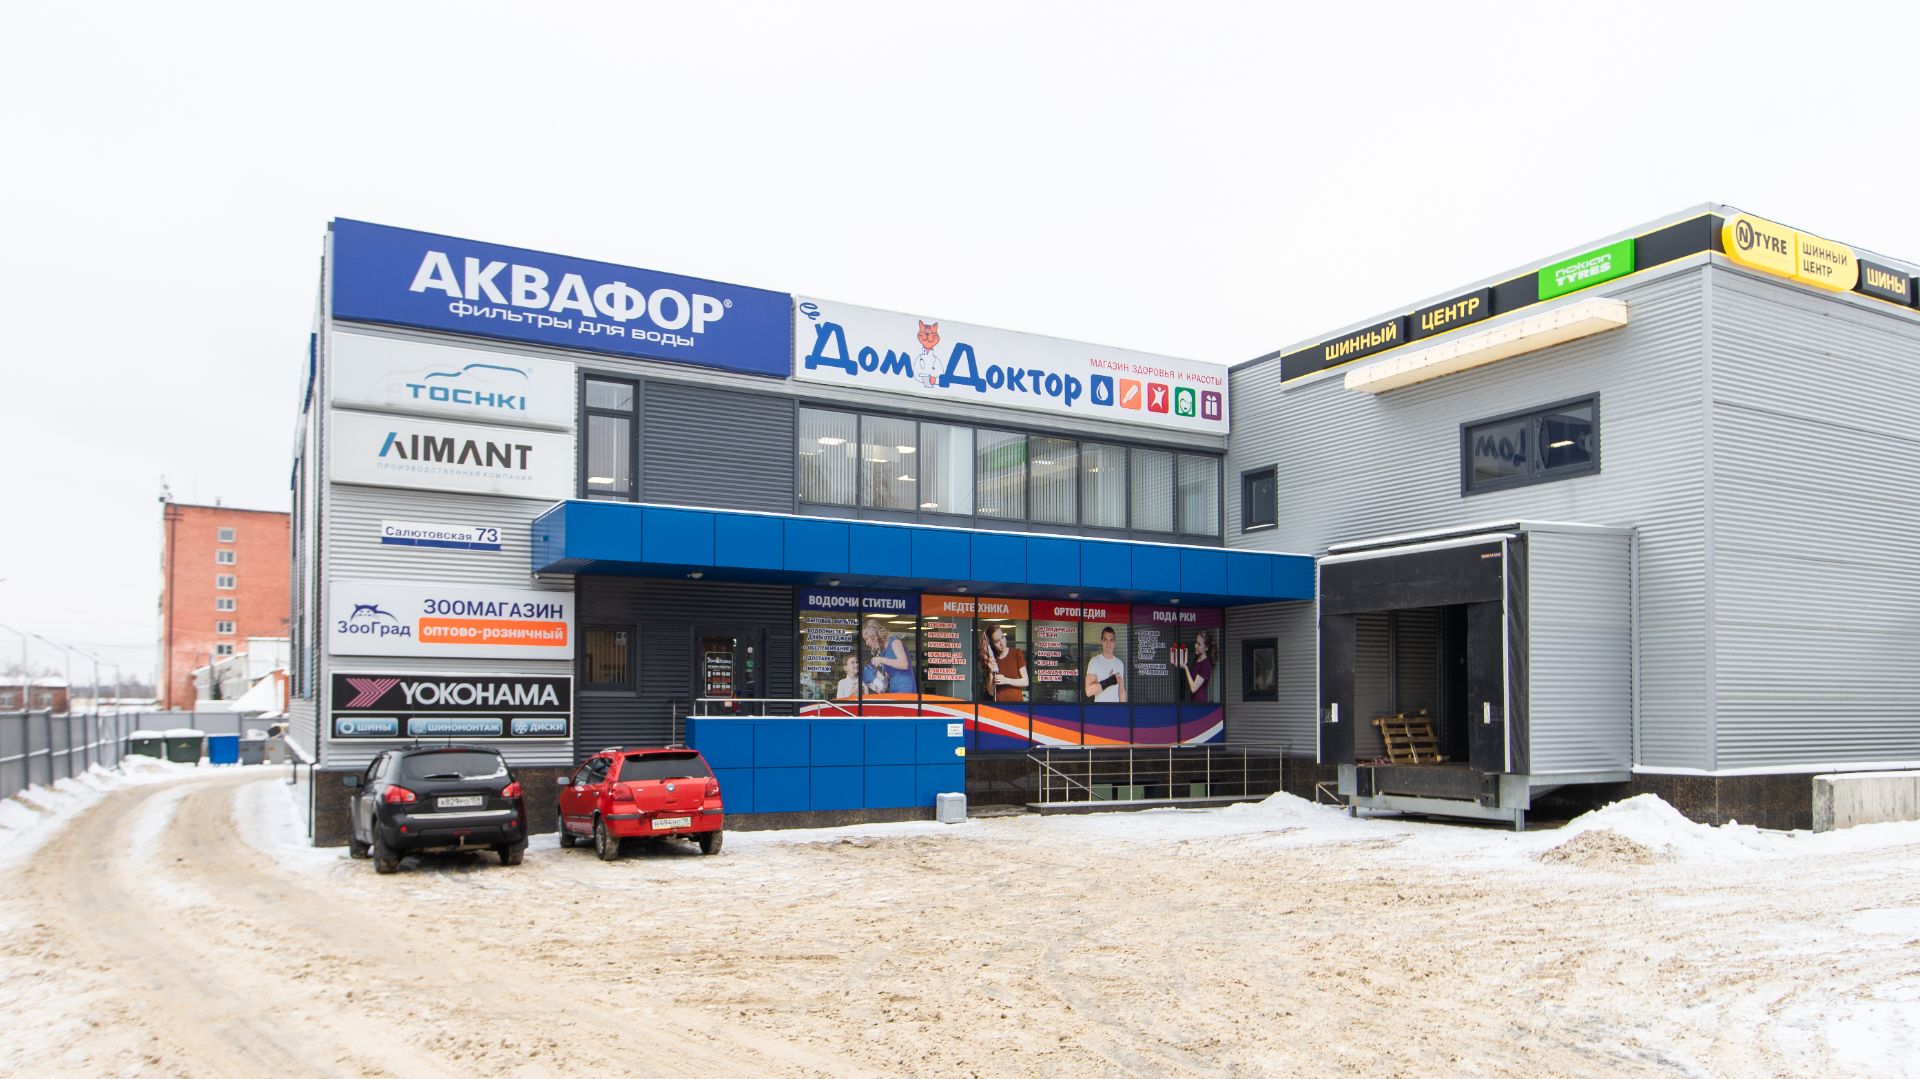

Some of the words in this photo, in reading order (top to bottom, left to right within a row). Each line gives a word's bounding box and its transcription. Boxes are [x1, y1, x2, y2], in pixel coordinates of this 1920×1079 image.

[1802, 242, 1847, 266] ШИННЫЙ
[1556, 262, 1612, 287] TYRES
[1803, 259, 1833, 277] ЦЕНТР
[408, 250, 725, 334] АКВАФОР
[1866, 267, 1906, 295] ШИНЫ
[449, 300, 572, 329] фильтры
[578, 321, 625, 337] для
[632, 329, 694, 347] воды
[1325, 322, 1397, 361] ШИННЫЙ
[1421, 297, 1480, 331] ЦЕНТР
[805, 321, 914, 378] Дом
[938, 342, 1083, 407] Доктор
[1090, 358, 1129, 372] МАГАЗИН
[1132, 364, 1175, 379] ЗДОРОВЬЯ
[1178, 372, 1184, 381] И
[1186, 373, 1222, 386] КРАСОТЫ
[405, 383, 526, 410] TOCHKI
[376, 462, 481, 477] ПРОИЗВОДСТВЕННАЯ
[483, 471, 533, 482] КОМПАНИЯ
[385, 526, 472, 541] Салютовская
[475, 527, 498, 543] 73
[423, 598, 563, 619] ЗООМАГАЗИН
[338, 620, 411, 637] ЗооГрад
[423, 623, 563, 641] оптово-розничный
[400, 681, 559, 706] YOKOHAMA
[357, 722, 392, 732] ШИНЫ
[427, 722, 499, 732] ШИНОМОНТАЖ
[530, 722, 564, 733] ДИСКИ
